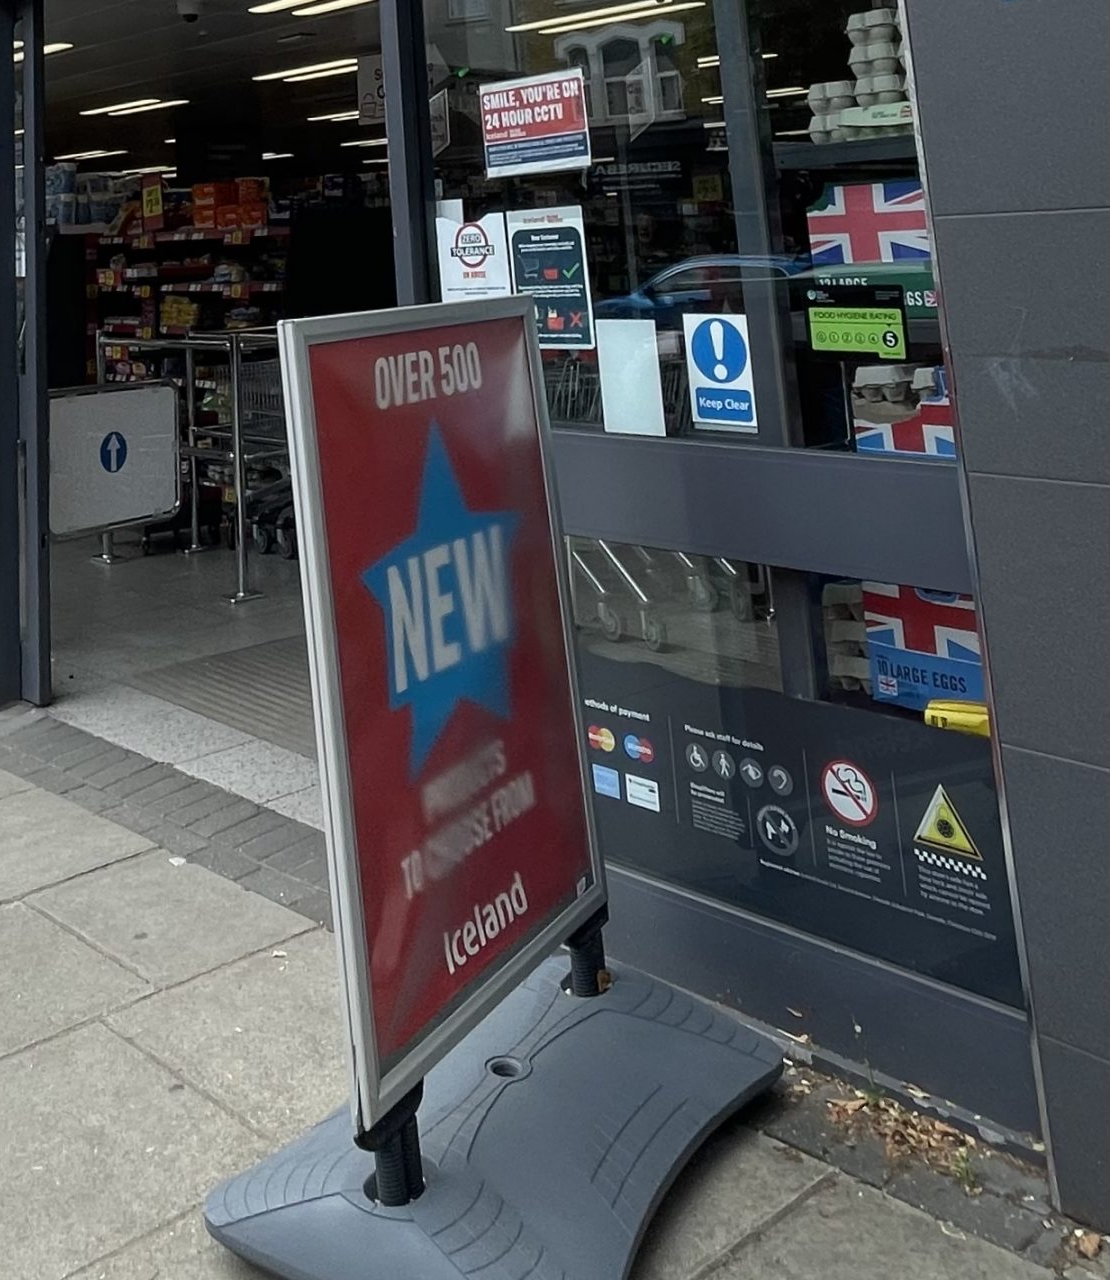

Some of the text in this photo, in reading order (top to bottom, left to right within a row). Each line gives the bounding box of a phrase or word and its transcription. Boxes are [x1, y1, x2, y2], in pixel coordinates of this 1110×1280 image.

[483, 80, 579, 110] SMILE, YOU'RE ON
[484, 102, 564, 130] 24 HOUR CCTV
[461, 233, 482, 244] ZERO
[451, 246, 494, 257] TOLERANCE
[904, 290, 923, 306] GS
[837, 312, 869, 320] HYGIENE
[886, 333, 896, 347] 5
[374, 341, 482, 410] OVER 500
[698, 396, 750, 412] Keep Clear
[387, 524, 510, 694] NEW
[876, 659, 889, 676] 10
[890, 663, 929, 686] LARGE
[932, 671, 967, 693] EGGS
[584, 698, 609, 712] ethods
[618, 707, 651, 722] payment
[825, 825, 877, 850] No Smoking
[401, 849, 424, 899] TO
[443, 871, 529, 975] Iceland
